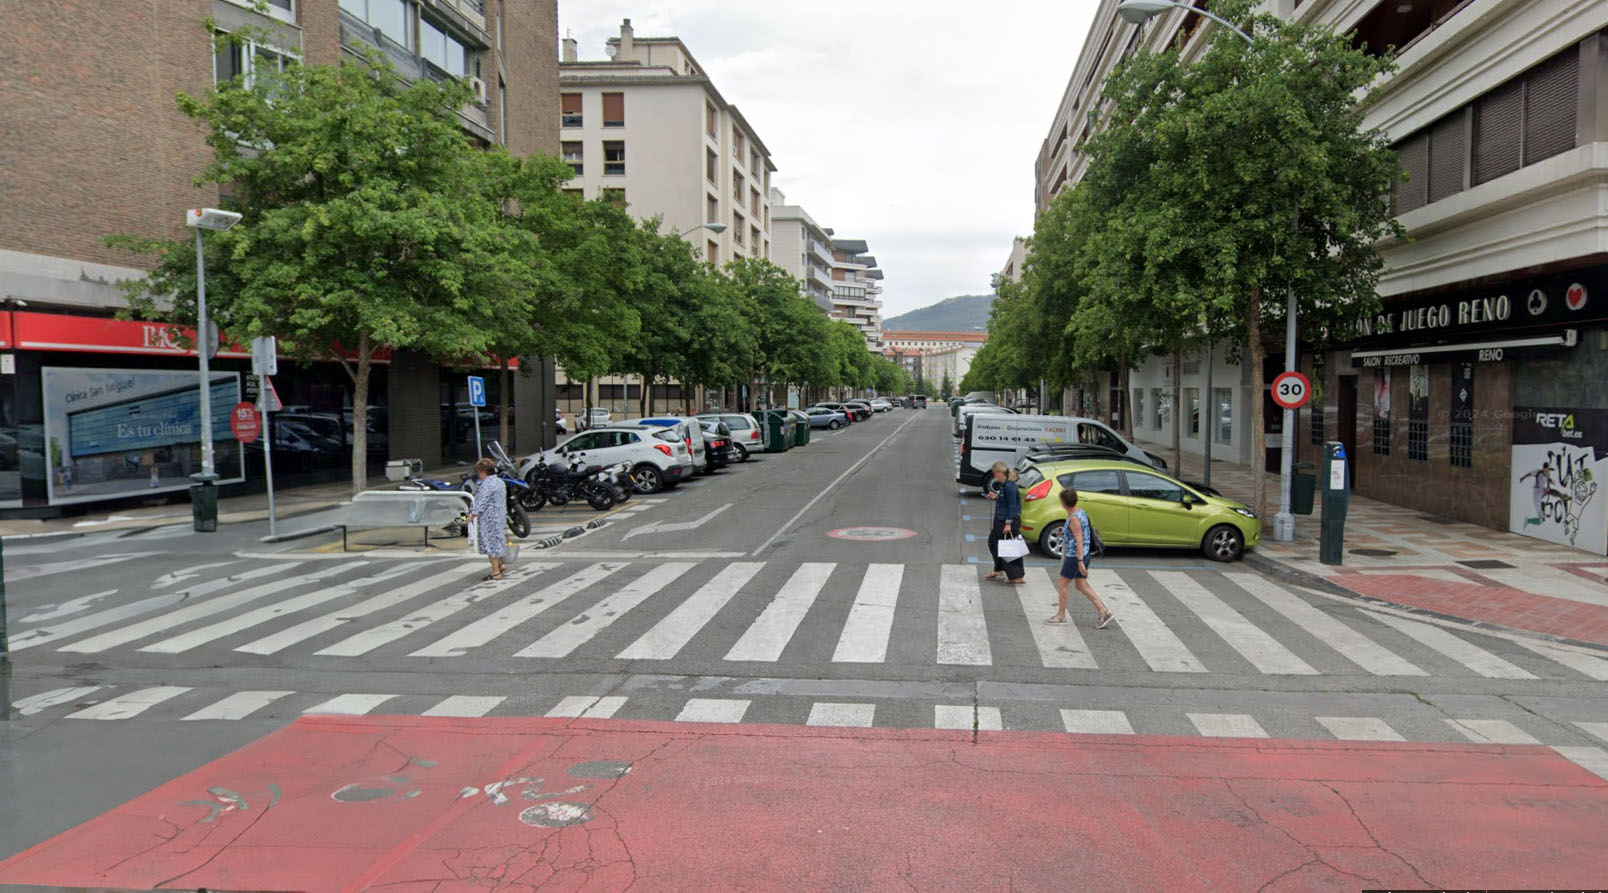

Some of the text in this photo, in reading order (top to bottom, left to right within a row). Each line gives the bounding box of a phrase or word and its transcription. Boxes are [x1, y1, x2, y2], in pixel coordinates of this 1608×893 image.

[1377, 313, 1394, 335] DE
[1400, 304, 1450, 332] JUEGO
[1458, 295, 1511, 325] RENO
[1384, 354, 1420, 367] RECREATIVO
[1479, 349, 1503, 362] RENO
[472, 381, 482, 402] P
[1280, 383, 1302, 396] 30
[117, 421, 192, 439] Es tu clínica
[1536, 412, 1575, 432] RETA
